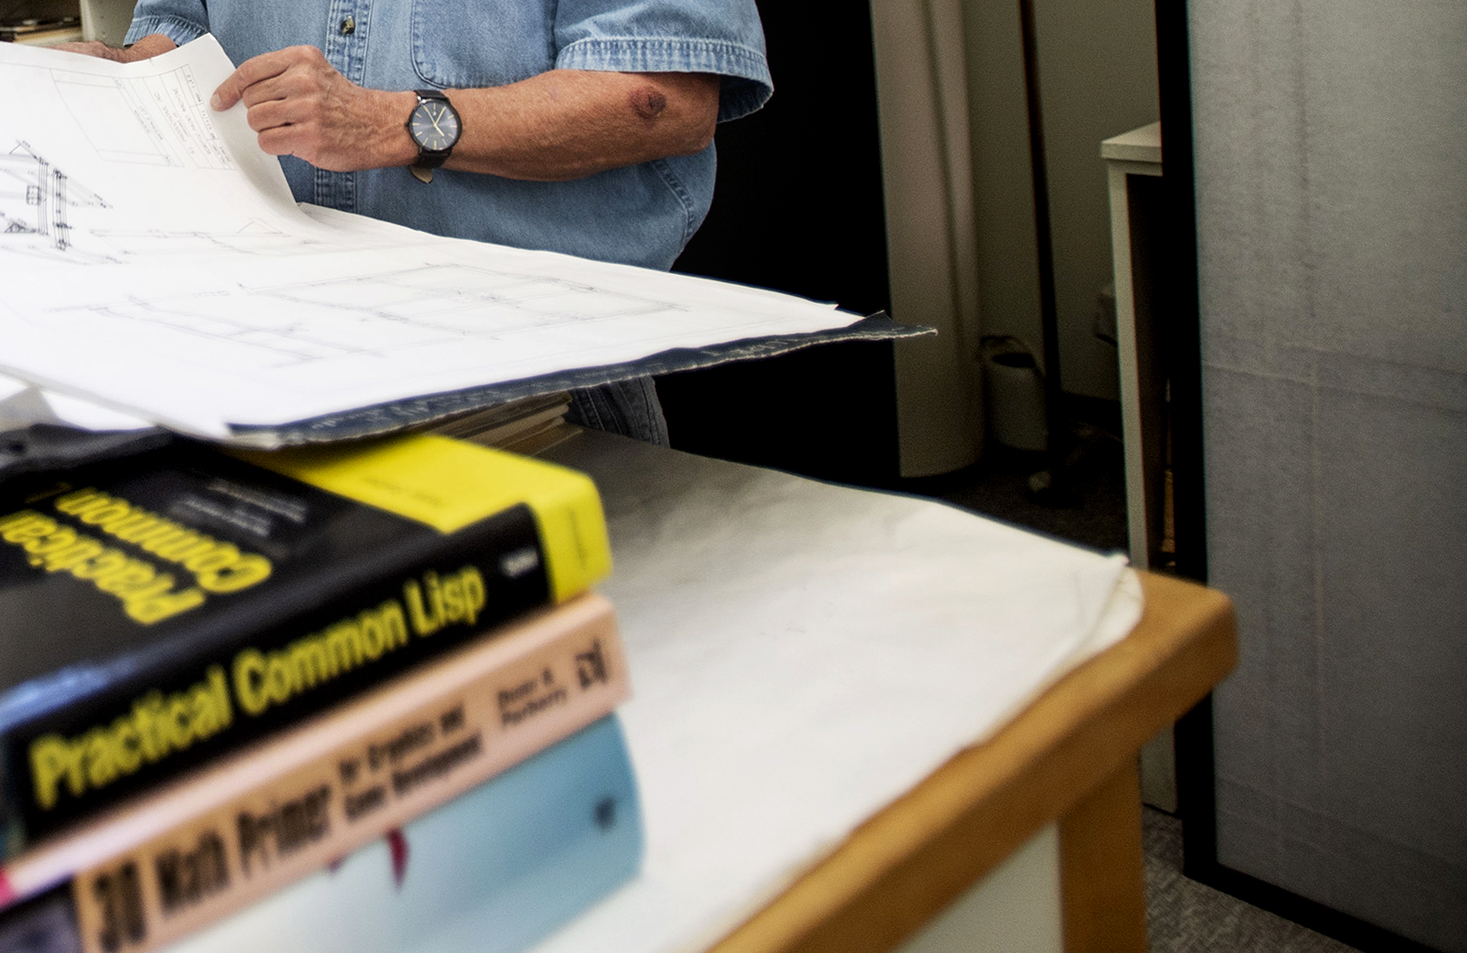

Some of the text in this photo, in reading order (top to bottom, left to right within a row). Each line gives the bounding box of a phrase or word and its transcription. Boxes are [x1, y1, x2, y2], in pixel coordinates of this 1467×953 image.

[55, 492, 273, 595] Common
[31, 567, 486, 810] Practical Common Lisp
[156, 829, 230, 918] Math
[238, 784, 332, 880] Primer
